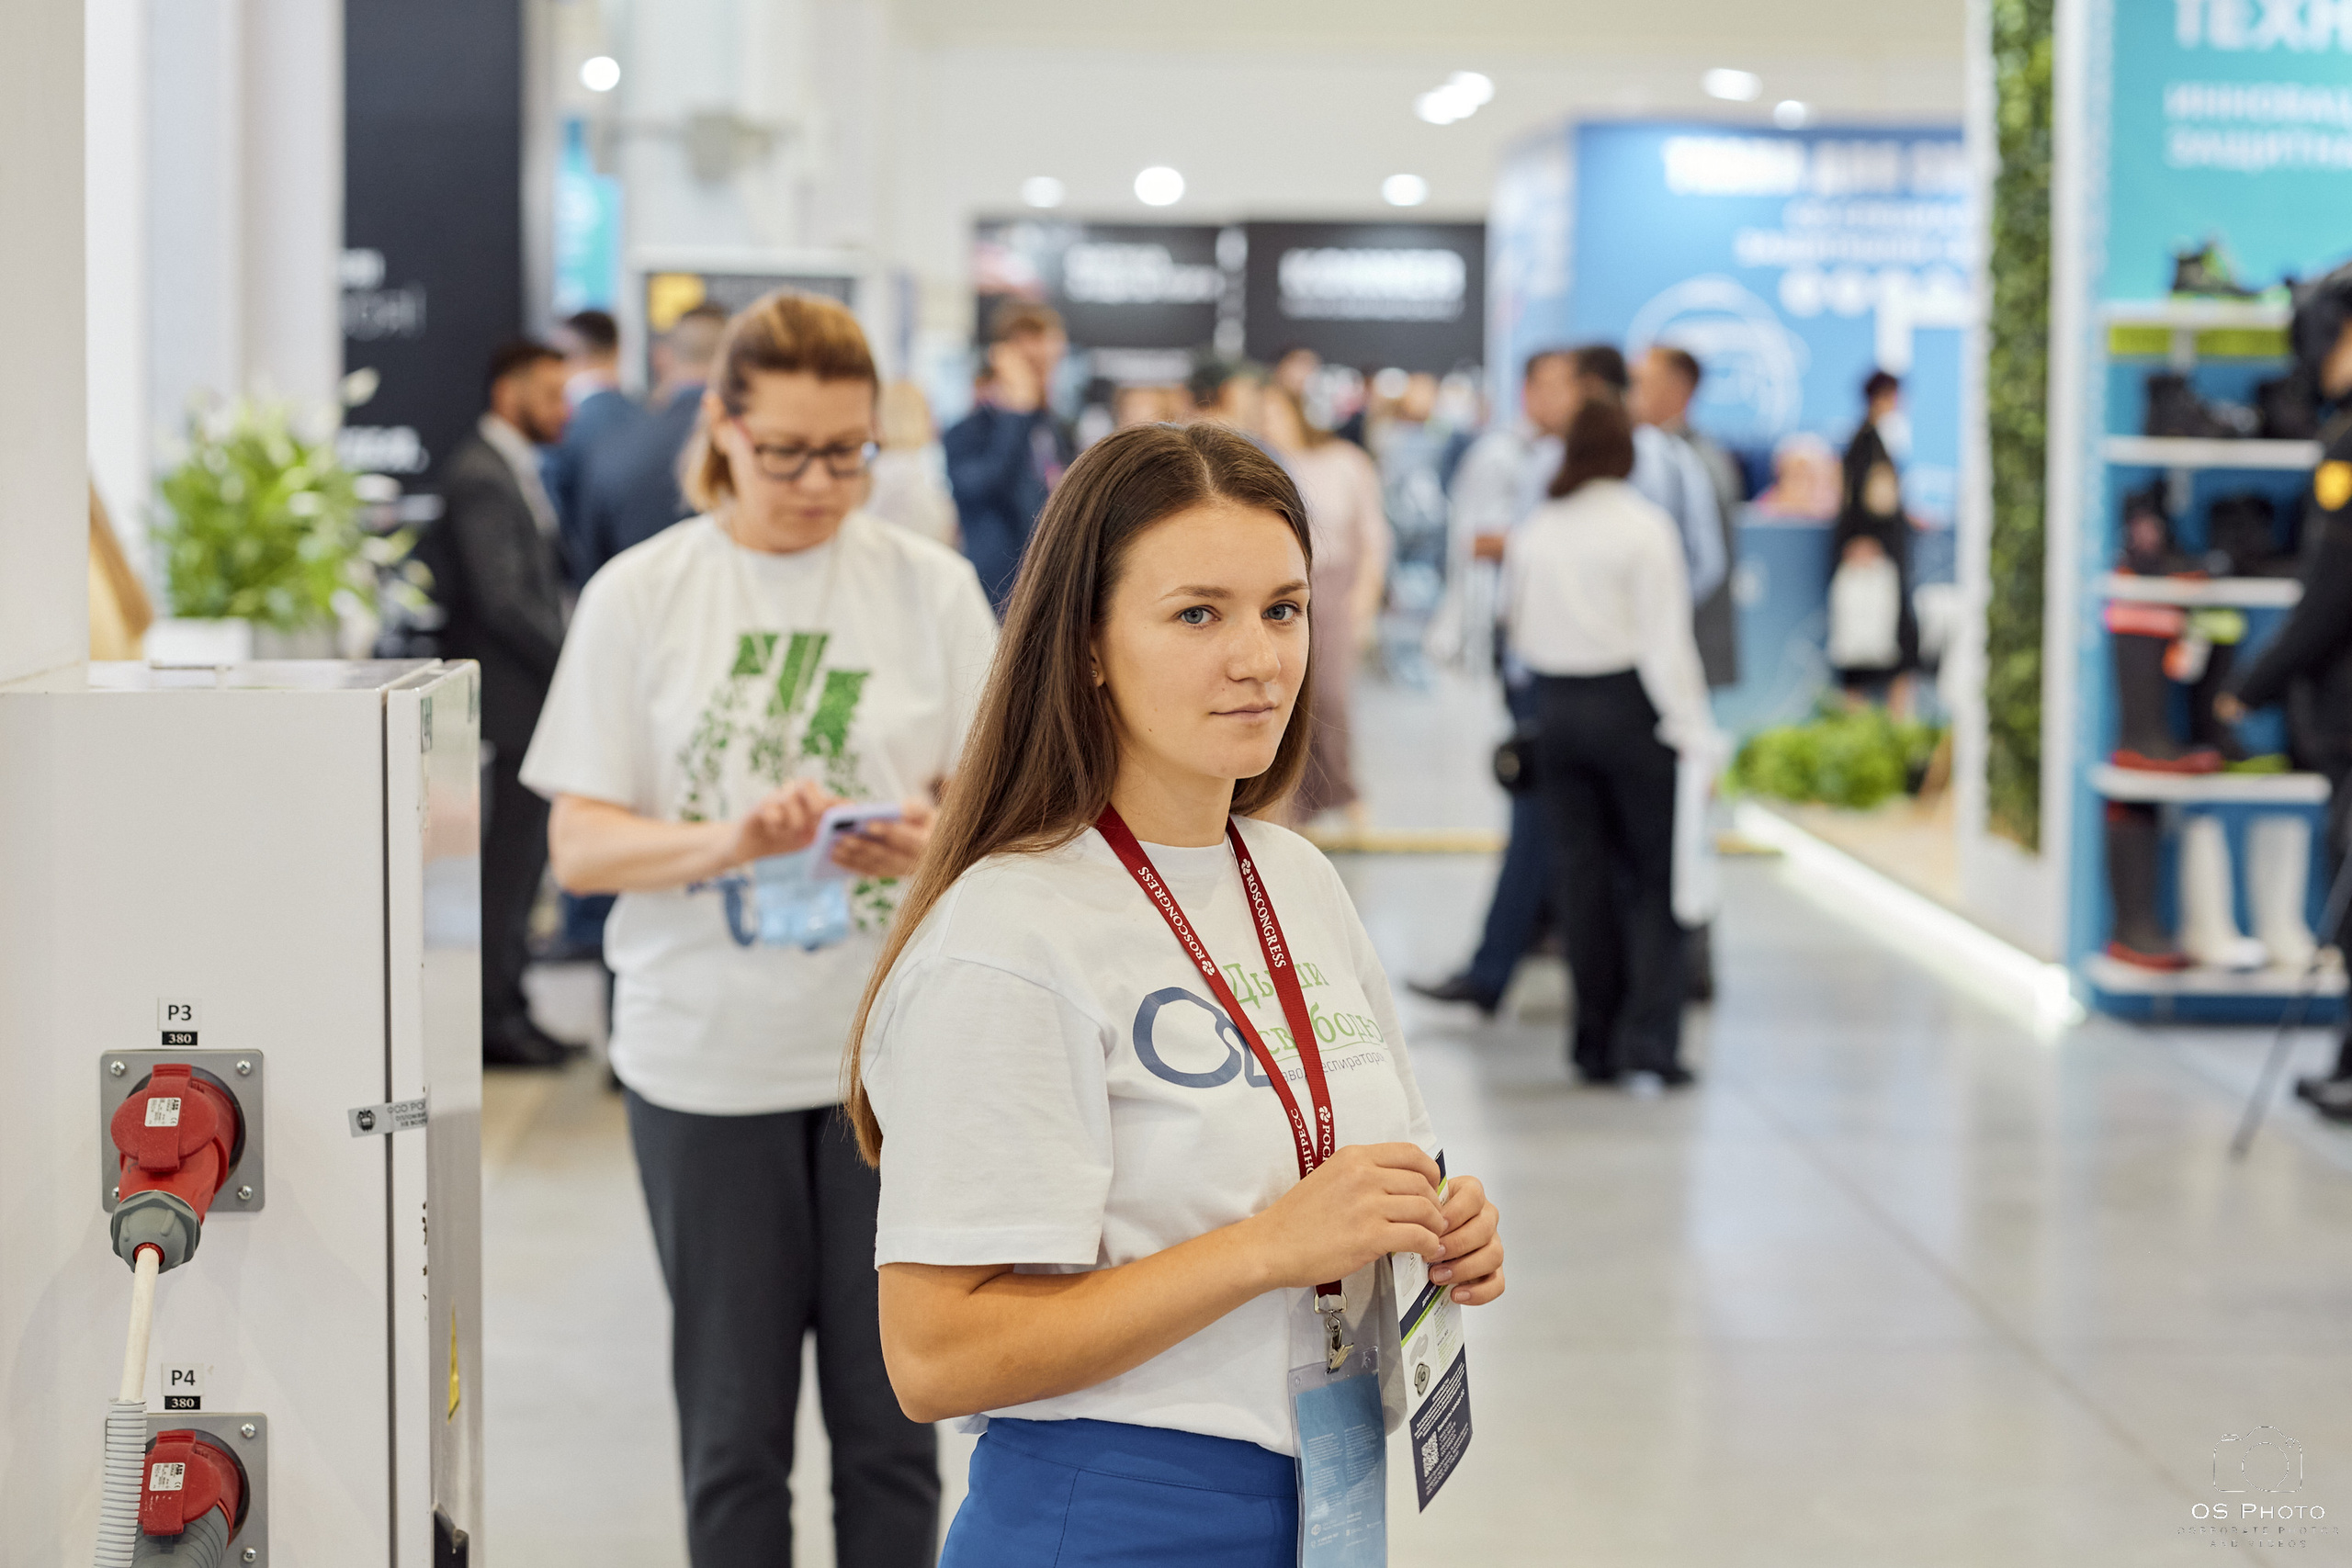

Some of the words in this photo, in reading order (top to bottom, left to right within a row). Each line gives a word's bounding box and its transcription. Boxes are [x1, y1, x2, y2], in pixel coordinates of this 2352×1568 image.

[1137, 866, 1205, 961] ROSCONGRESS
[1246, 874, 1287, 968] ROSCONGRESS
[168, 1004, 192, 1021] P3
[168, 1033, 192, 1043] 380
[171, 1370, 196, 1386] P4
[171, 1398, 195, 1408] 380
